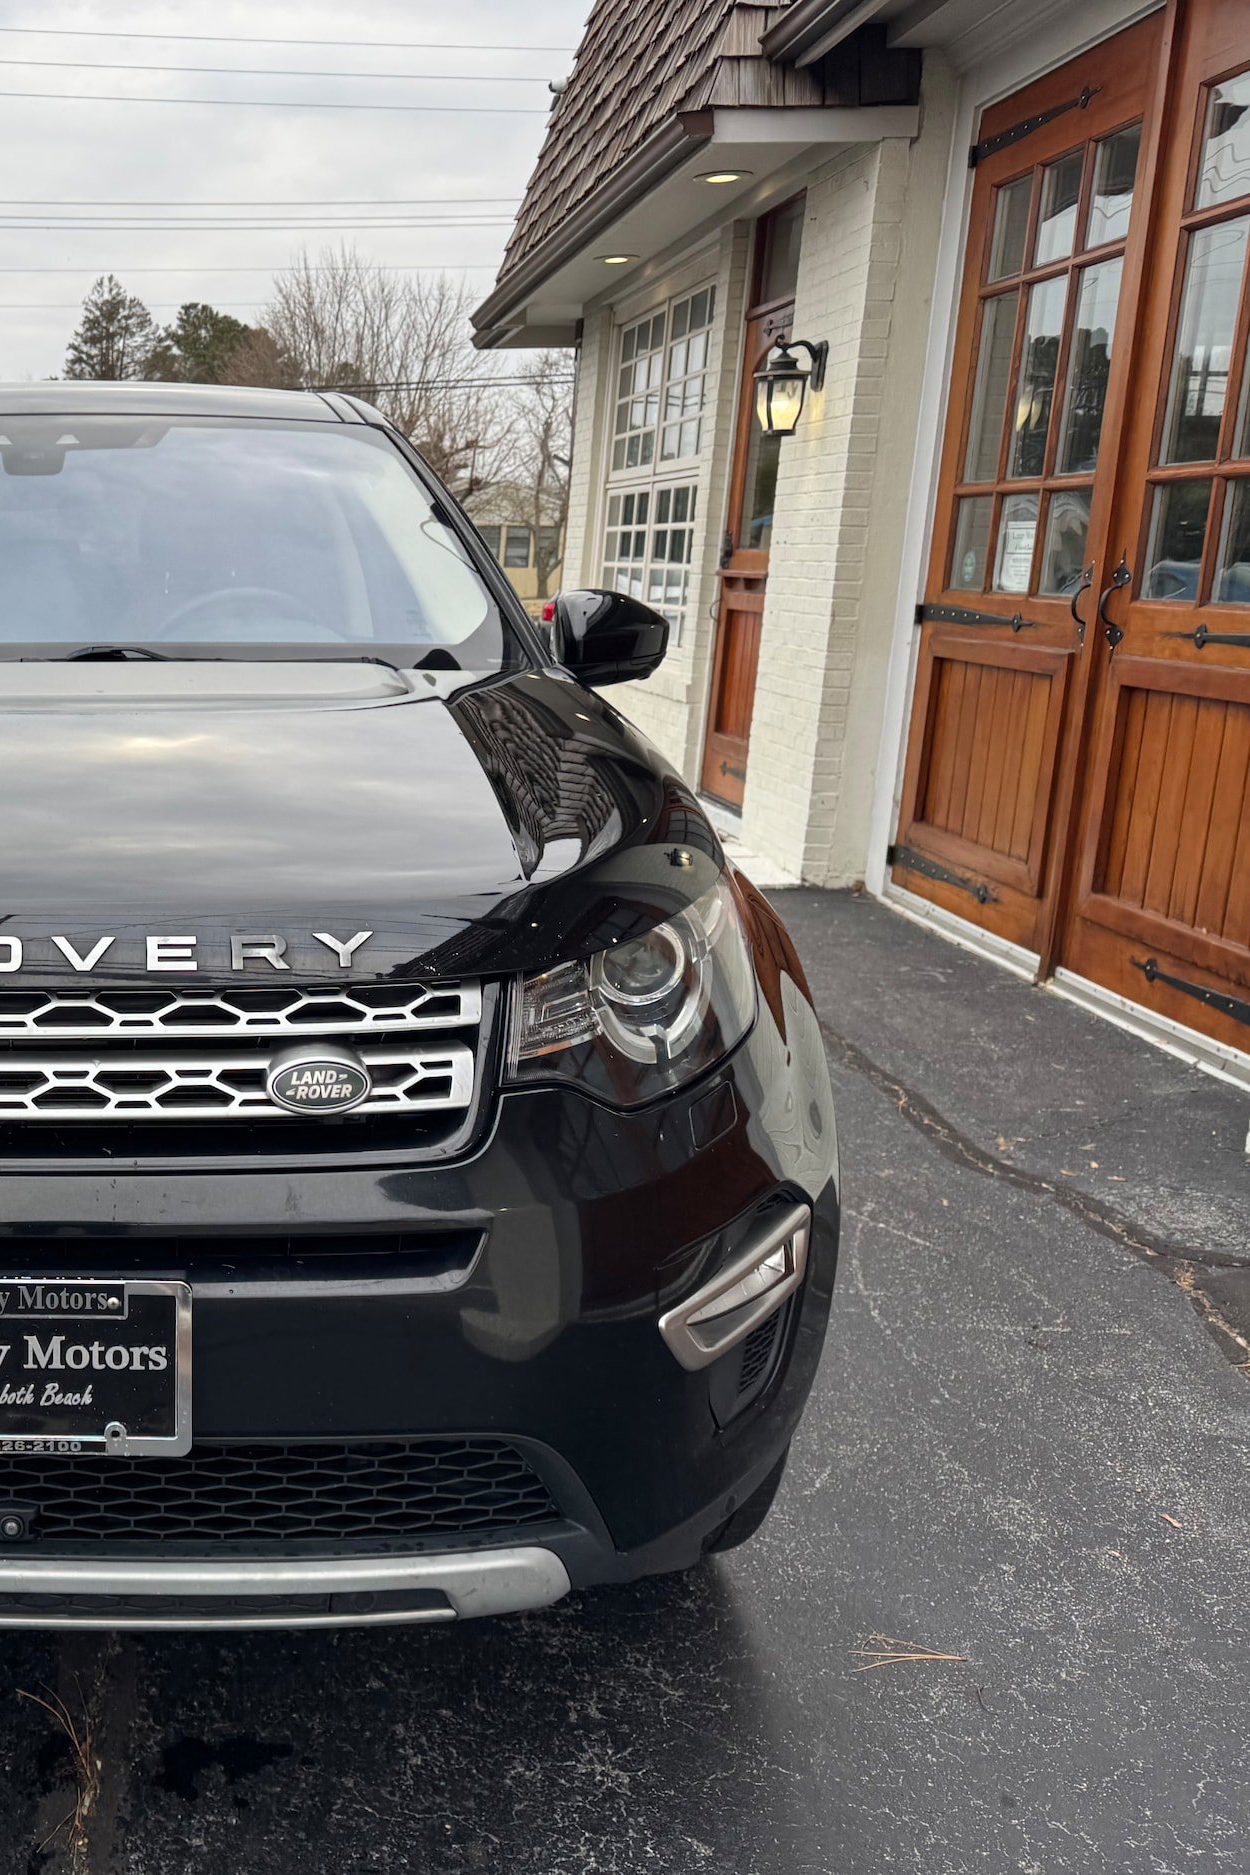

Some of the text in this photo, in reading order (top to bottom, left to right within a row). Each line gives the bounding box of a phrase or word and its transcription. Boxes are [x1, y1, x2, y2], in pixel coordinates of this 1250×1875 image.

[291, 1070, 338, 1086] LAND
[296, 1084, 353, 1100] ROVER
[17, 1285, 108, 1311] Motors
[23, 1335, 168, 1371] Motors
[40, 1383, 93, 1407] Beach
